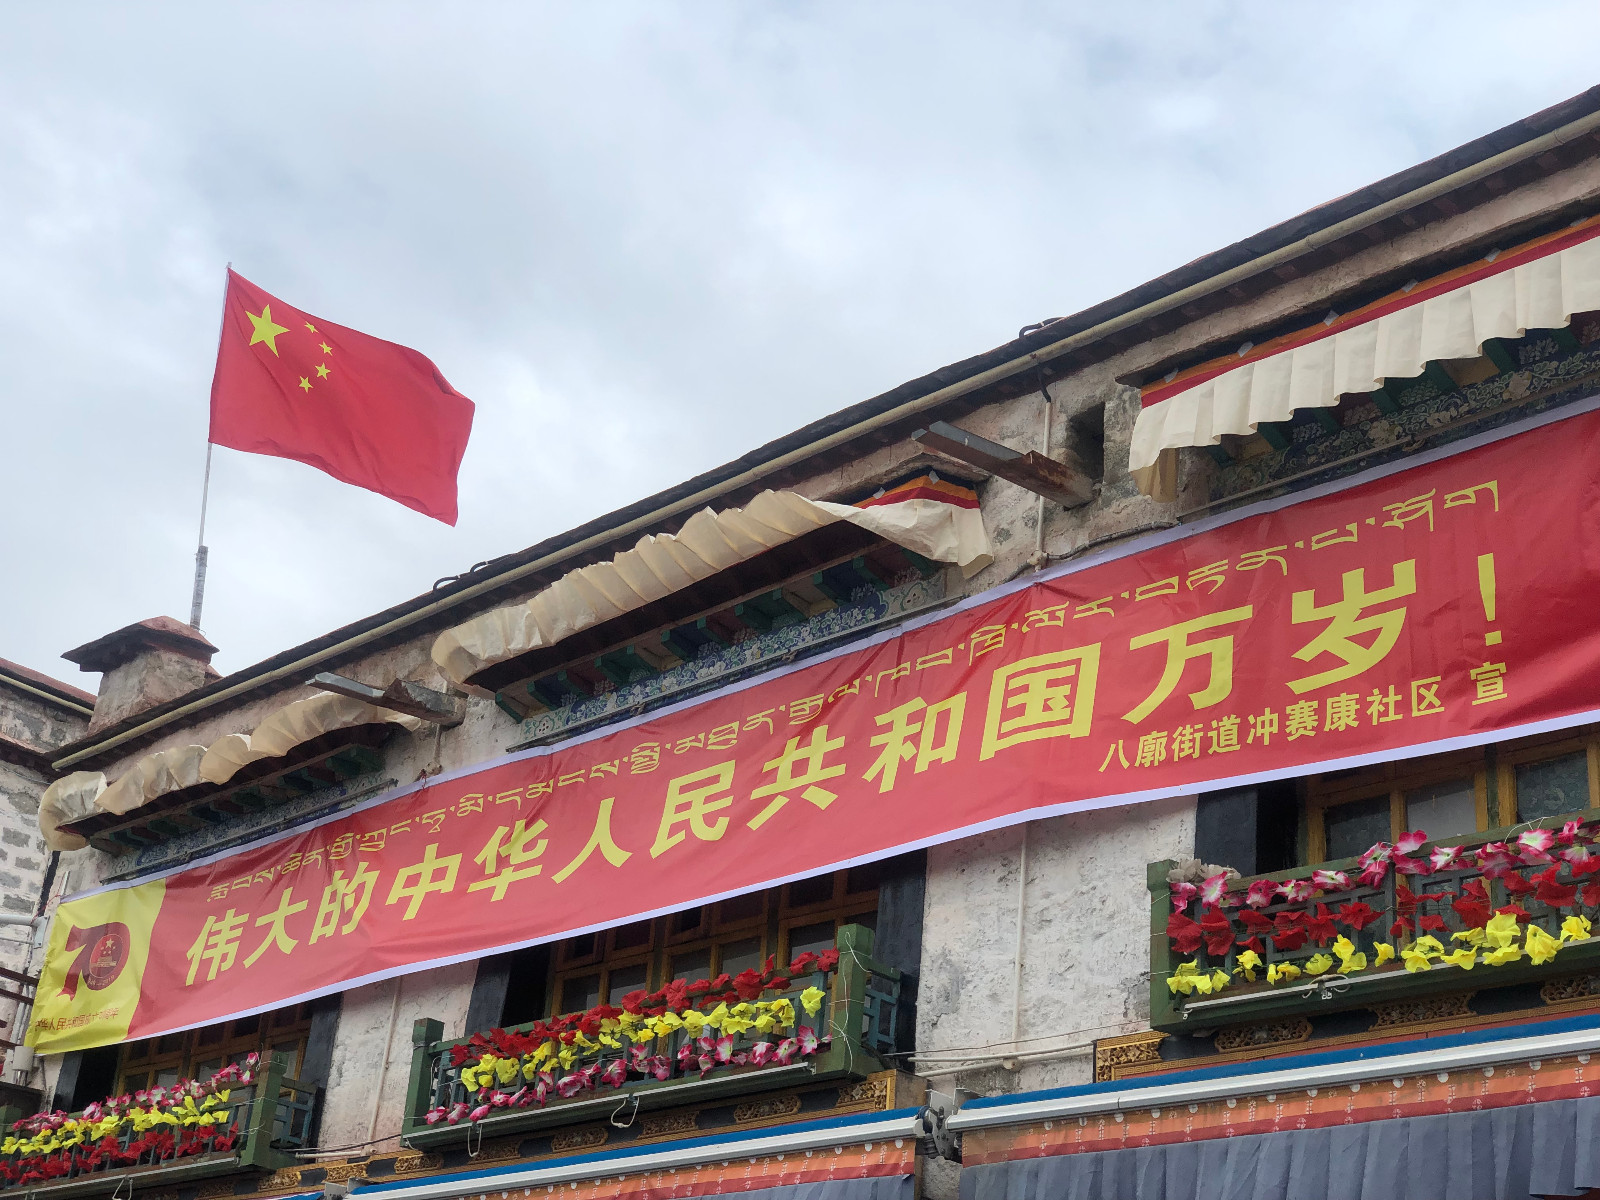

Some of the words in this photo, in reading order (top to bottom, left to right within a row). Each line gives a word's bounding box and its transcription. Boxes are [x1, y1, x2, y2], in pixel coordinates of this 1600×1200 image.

[186, 553, 1503, 986] 伟大的中华人民共和国万岁！
[1098, 675, 1445, 774] 八廓街道冲赛康社区
[1470, 661, 1508, 710] 宣
